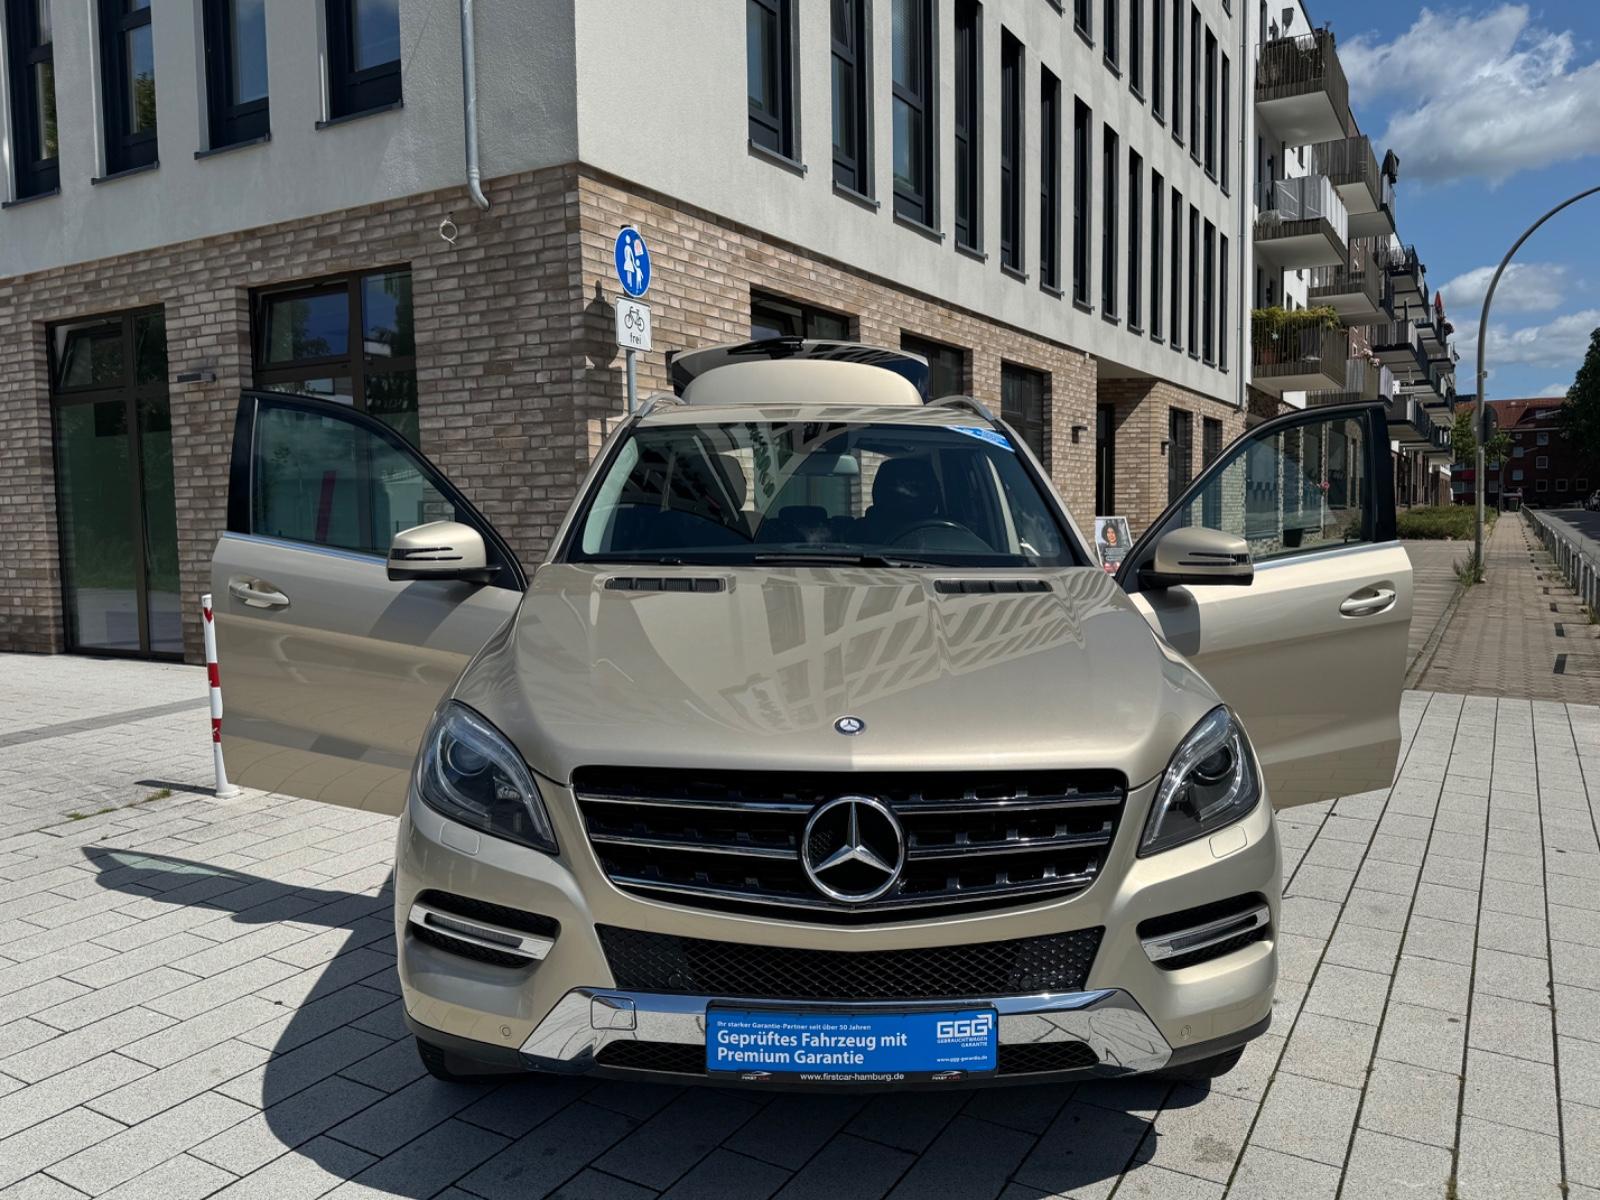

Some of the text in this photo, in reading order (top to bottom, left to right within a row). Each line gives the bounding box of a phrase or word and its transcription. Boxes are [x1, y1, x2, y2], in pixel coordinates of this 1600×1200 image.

[630, 332, 642, 345] frei
[728, 1021, 752, 1029] starker
[809, 1023, 822, 1031] seit
[848, 1023, 872, 1031] Jahren
[937, 1018, 988, 1038] GGG
[717, 1029, 908, 1051] Geprüftes Fahrzeug mit
[717, 1046, 865, 1065] Premium Garantie
[800, 1072, 905, 1082] www.firstcar-hamburg.de
